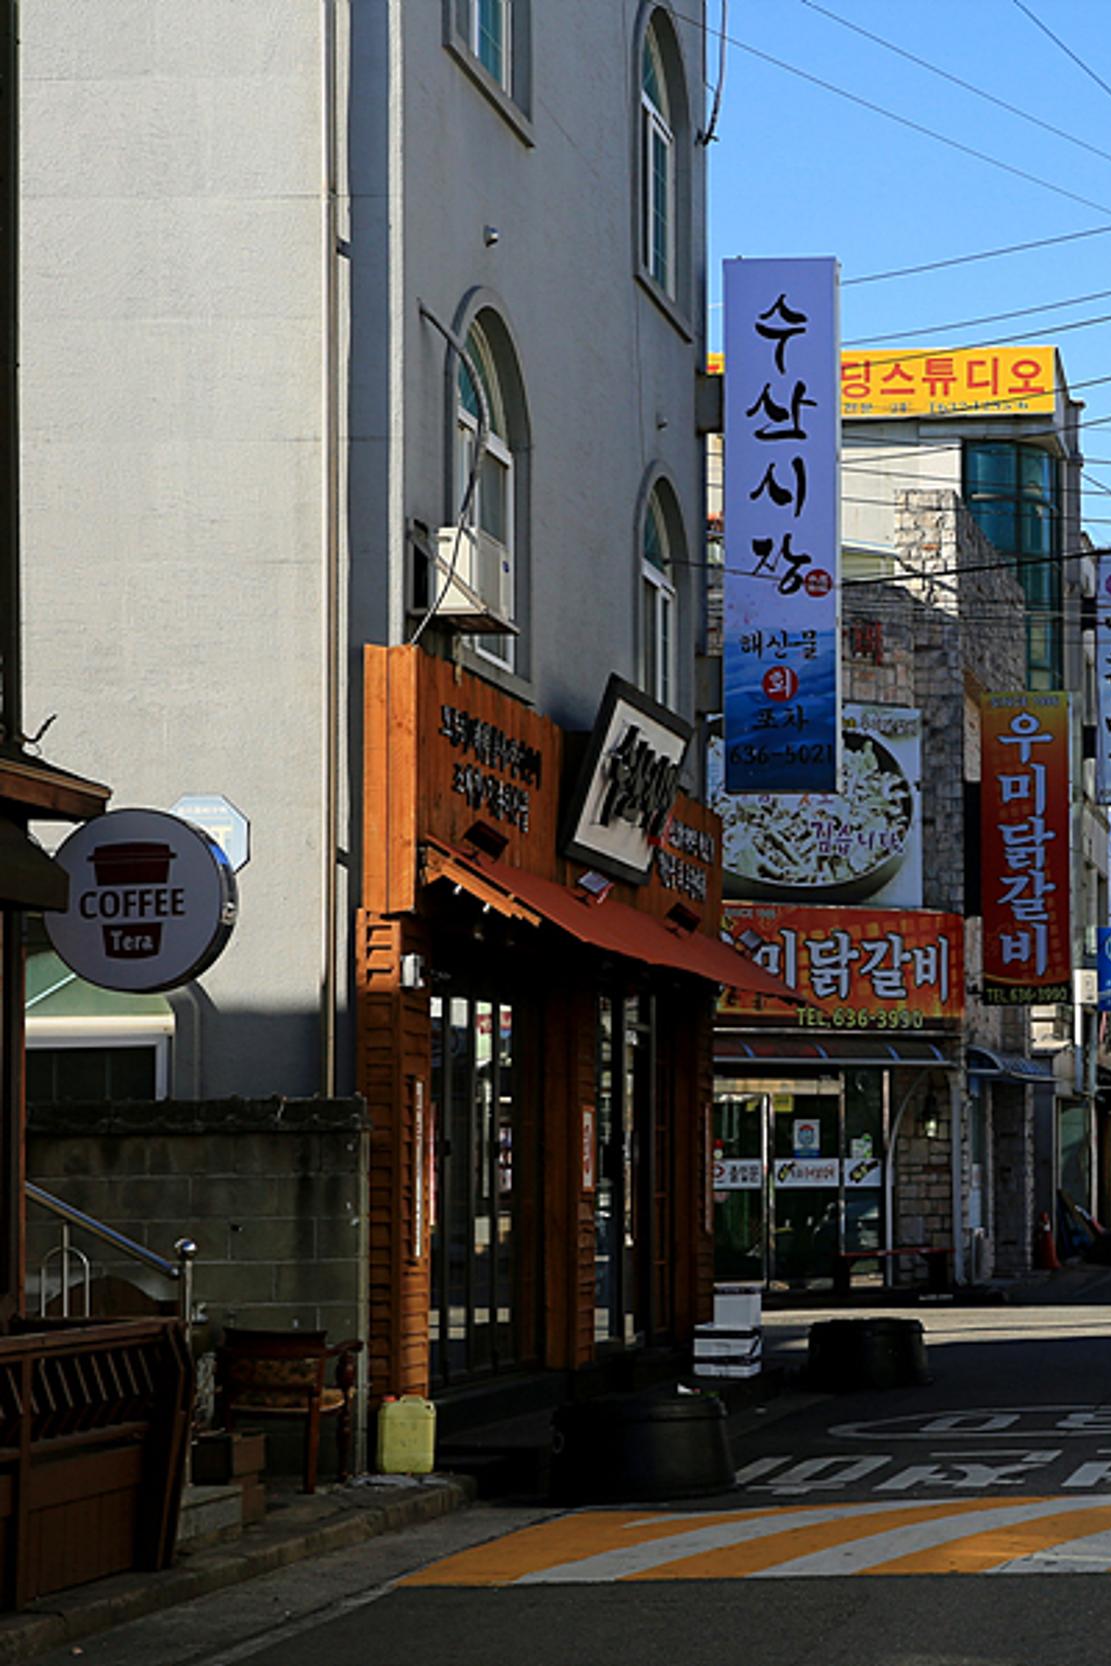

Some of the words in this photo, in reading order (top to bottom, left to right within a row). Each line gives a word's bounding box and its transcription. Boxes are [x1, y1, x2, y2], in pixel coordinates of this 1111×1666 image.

[746, 294, 818, 595] 수산시장
[740, 629, 817, 660] 해산물
[768, 669, 793, 698] 회
[752, 704, 810, 733] 포차
[730, 743, 833, 765] 636-5021
[997, 711, 1056, 977] 우미닭갈비
[79, 888, 186, 919] COFFEE
[110, 930, 153, 951] Tera
[719, 928, 949, 1004] 미닭갈비
